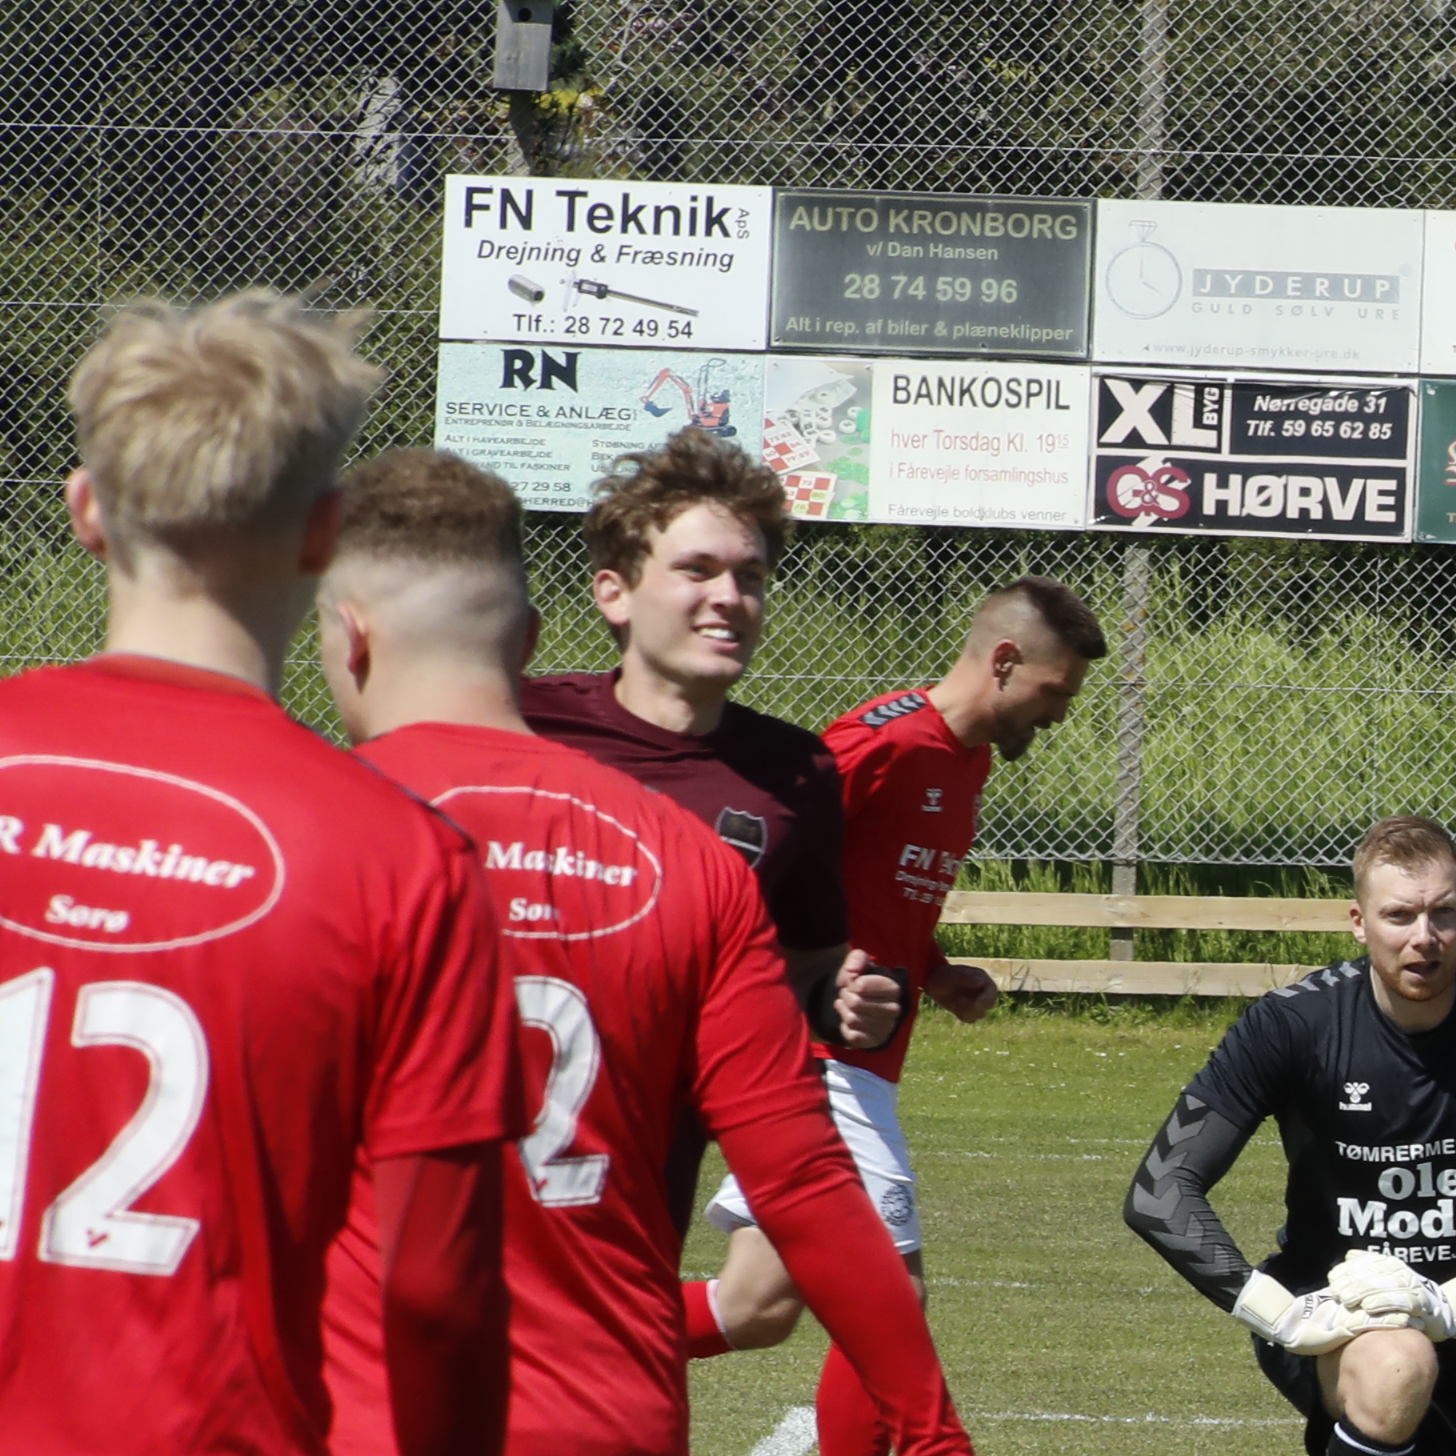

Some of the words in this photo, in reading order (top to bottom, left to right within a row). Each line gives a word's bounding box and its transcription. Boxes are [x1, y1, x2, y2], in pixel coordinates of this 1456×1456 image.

[463, 186, 533, 231] FN
[556, 190, 732, 238] Teknik
[790, 207, 878, 233] AUTO
[889, 210, 1077, 239] KRONBORG
[477, 240, 581, 267] Drejning
[591, 245, 606, 263] &
[616, 245, 734, 272] Fræsning
[888, 243, 923, 258] Dan
[930, 244, 998, 260] Hansen
[844, 274, 880, 299] 28
[891, 276, 926, 300] 74
[936, 277, 971, 301] 59
[980, 279, 1018, 303] 96
[1200, 274, 1391, 298] JYDERUP
[1275, 305, 1335, 317] SØLV
[513, 315, 555, 333] Tlf.:
[564, 316, 589, 334] 28
[600, 318, 624, 336] 72
[632, 319, 658, 337] 49
[667, 321, 693, 338] 54
[786, 318, 811, 332] Alt
[826, 322, 858, 336] rep.
[866, 319, 882, 334] af
[888, 320, 927, 335] biler
[953, 324, 1073, 342] plæneklipper
[500, 349, 581, 393] RN
[892, 374, 1070, 410] BANKOSPIL
[1254, 395, 1358, 415] Nørregade
[1363, 397, 1387, 414] 31
[445, 403, 531, 417] SERVICE
[537, 406, 549, 417] &
[555, 406, 631, 420] ANLÆG
[1099, 379, 1218, 448] XL
[1203, 387, 1220, 425] BYG
[891, 429, 926, 449] hver
[933, 429, 999, 456] Torsdag
[1008, 433, 1027, 452] Kl.
[1247, 420, 1276, 436] Tlf.
[1282, 421, 1305, 436] 59
[1310, 422, 1334, 438] 65
[1339, 422, 1363, 438] 62
[1369, 423, 1392, 439] 85
[532, 482, 549, 491] 29
[553, 483, 571, 492] 58
[899, 462, 960, 483] Fårevejle
[965, 465, 1068, 487] forsamlingshus
[1203, 473, 1397, 522] HØRVE
[888, 504, 948, 520] Fårevejle
[953, 506, 1016, 520] boldklubs
[1020, 510, 1067, 521] venner
[33, 823, 255, 889] Maskiner
[899, 843, 936, 870] FN
